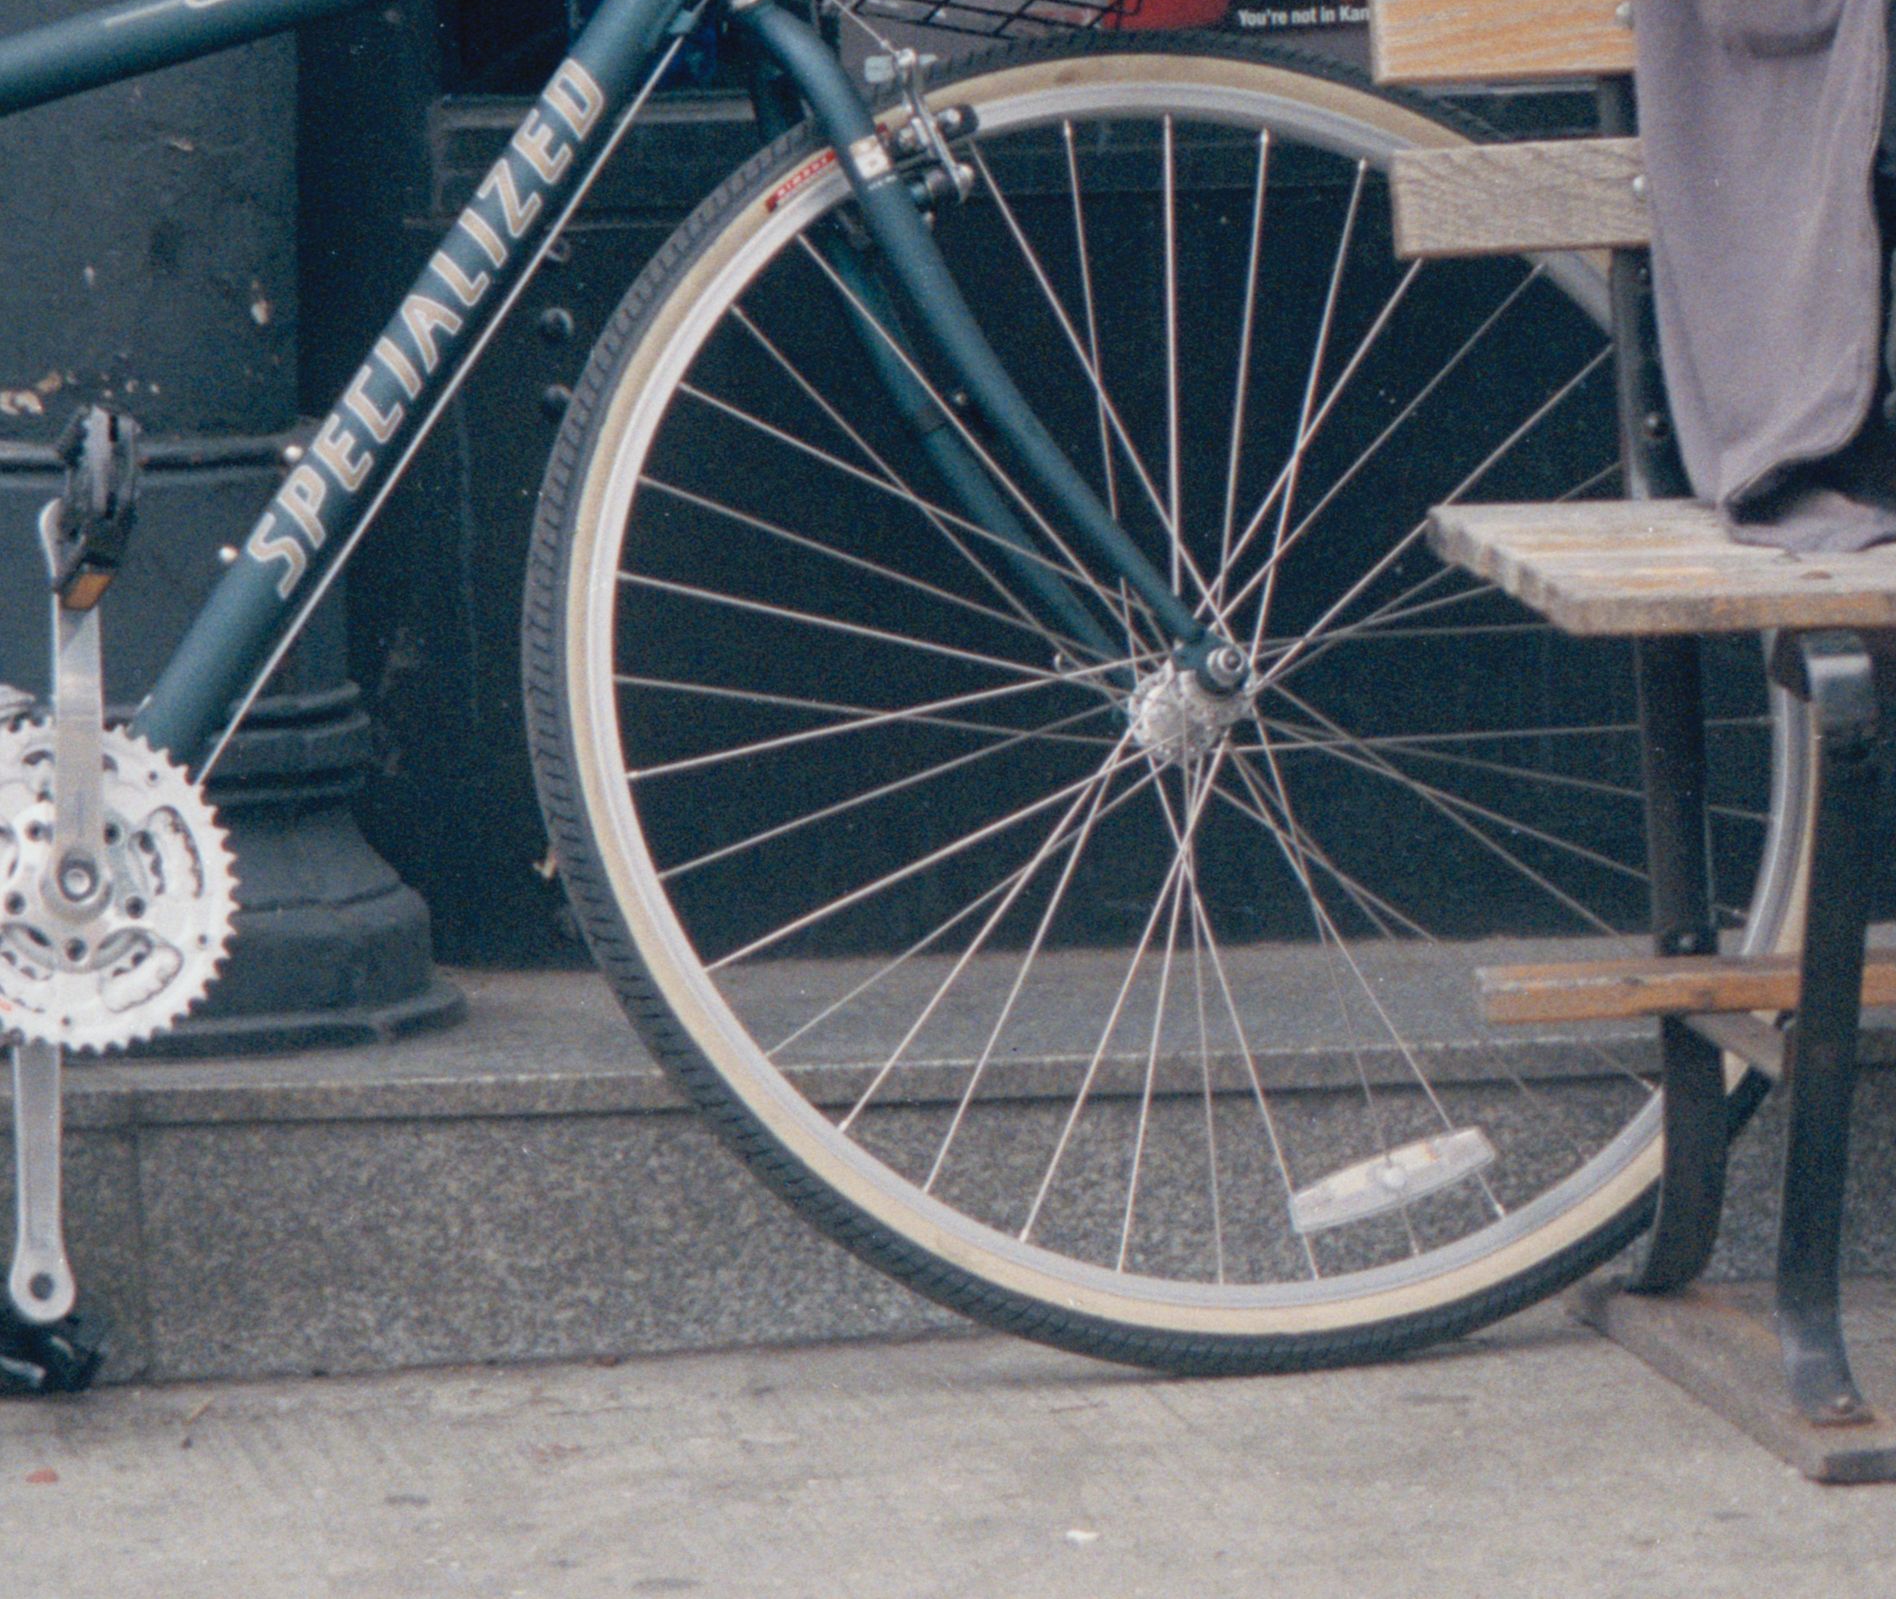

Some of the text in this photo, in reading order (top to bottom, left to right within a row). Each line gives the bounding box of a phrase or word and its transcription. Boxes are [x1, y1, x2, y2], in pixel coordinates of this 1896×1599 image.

[1238, 8, 1288, 27] You're
[1291, 7, 1316, 22] not
[1321, 5, 1335, 22] in
[246, 57, 604, 600] SPECIALIZED
